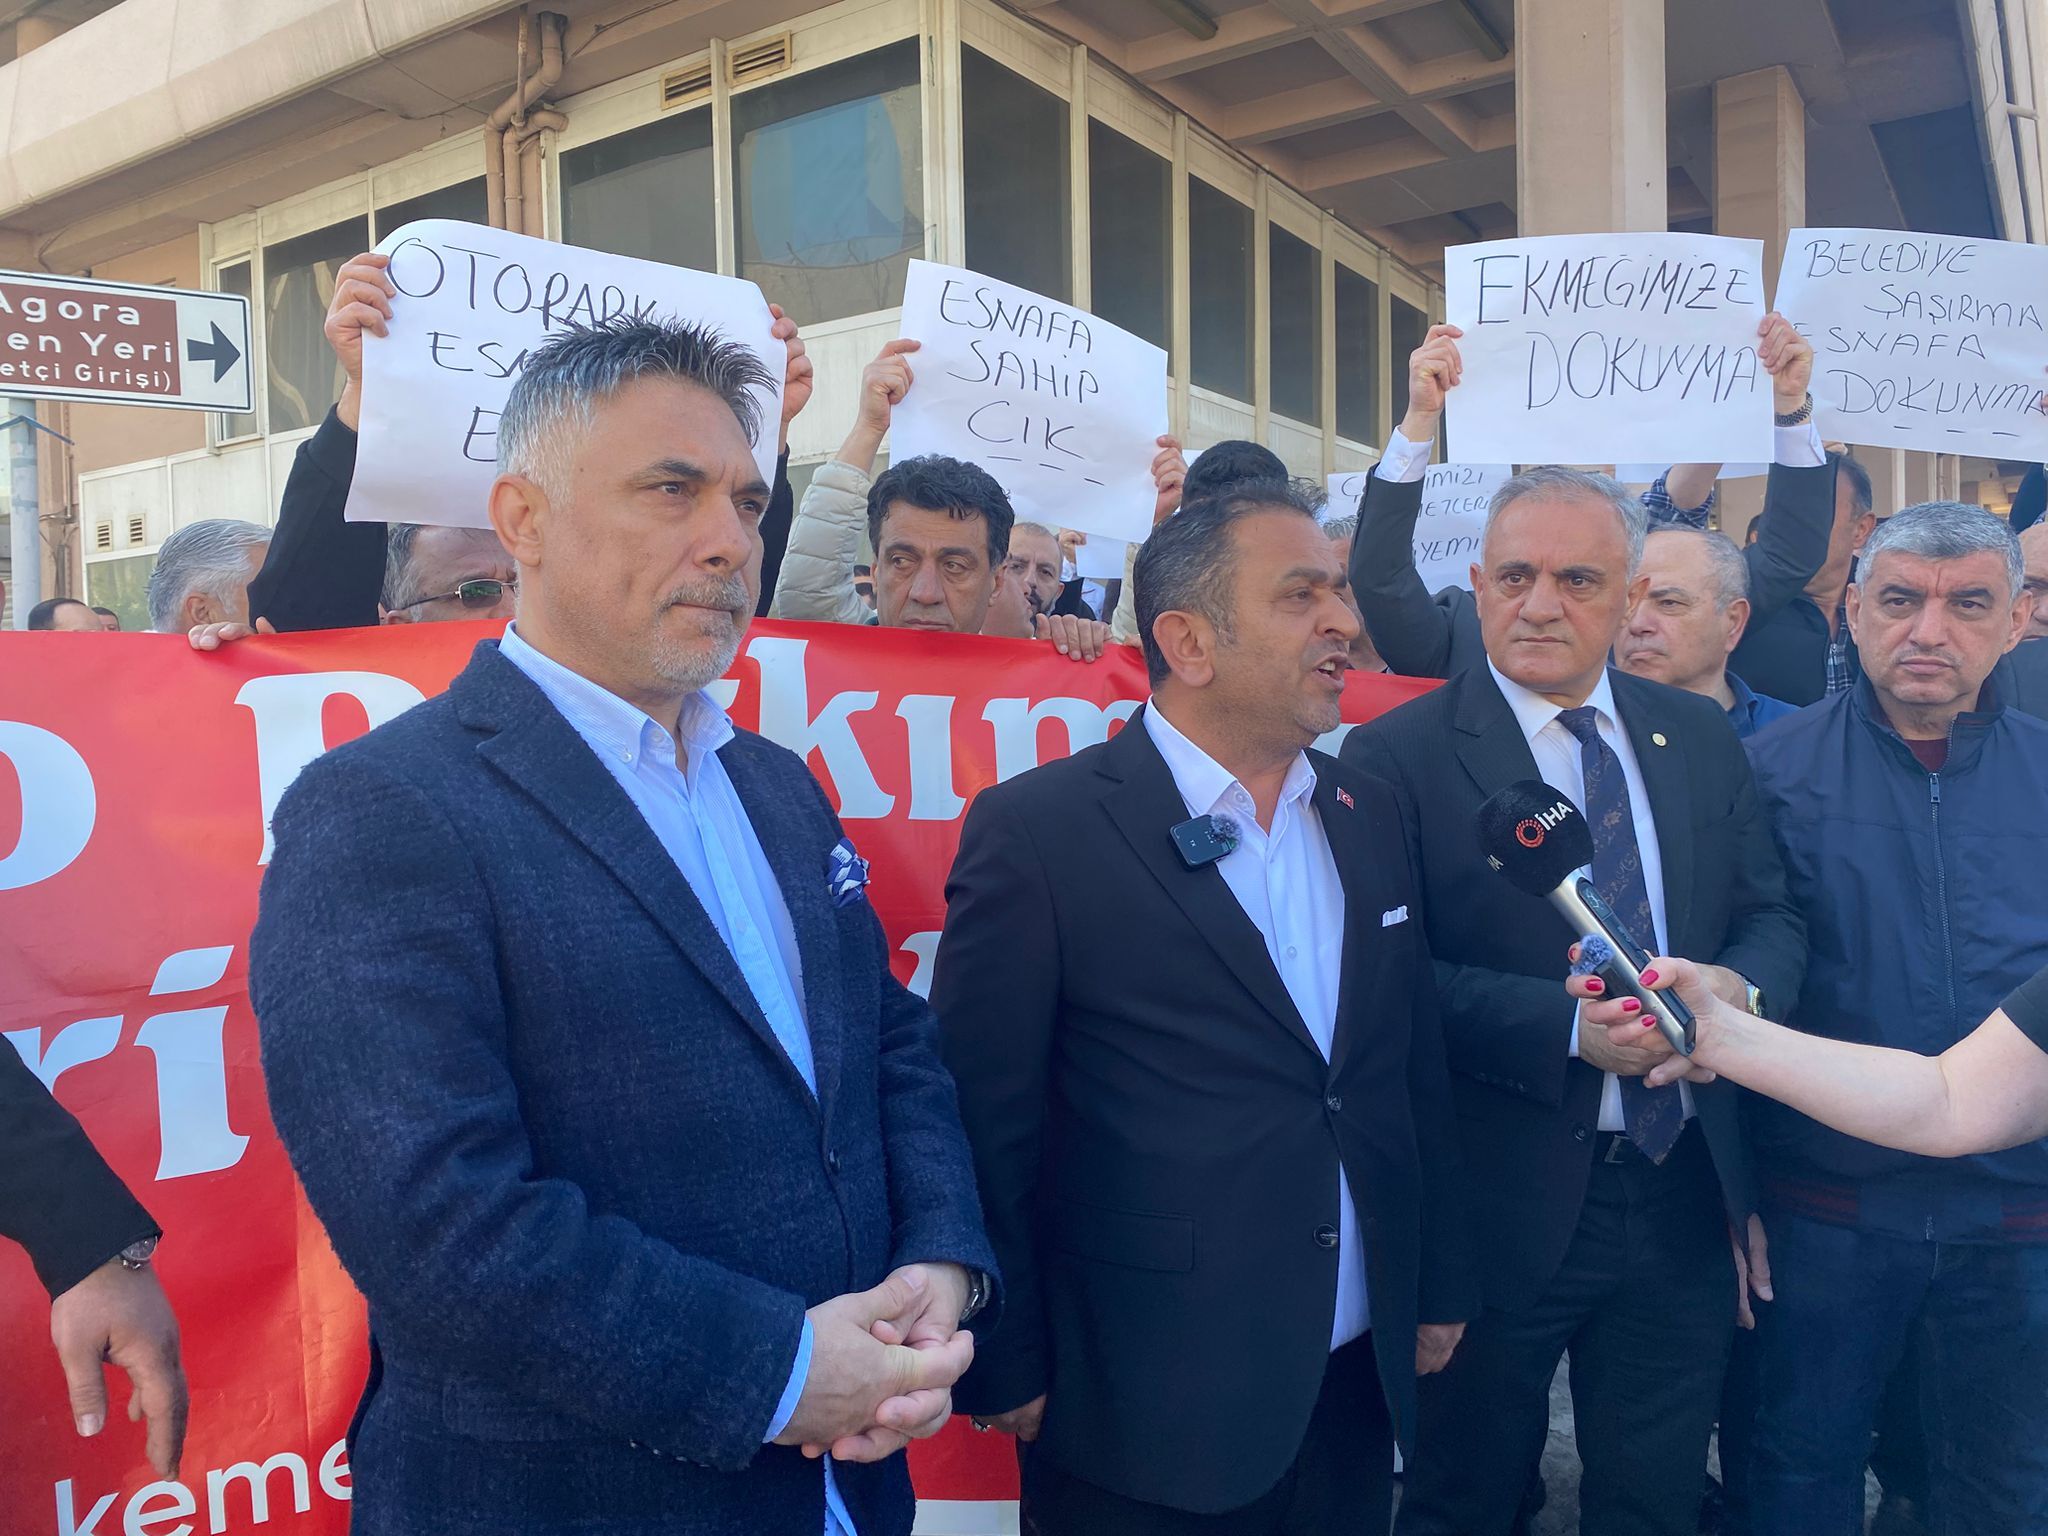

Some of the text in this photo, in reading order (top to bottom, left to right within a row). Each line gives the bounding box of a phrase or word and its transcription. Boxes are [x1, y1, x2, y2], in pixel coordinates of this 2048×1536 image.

[940, 280, 1091, 353] ESNAFA
[80, 331, 171, 362] Yeri
[1525, 331, 1757, 410] DOKUNMA
[75, 363, 170, 392] Girişi)
